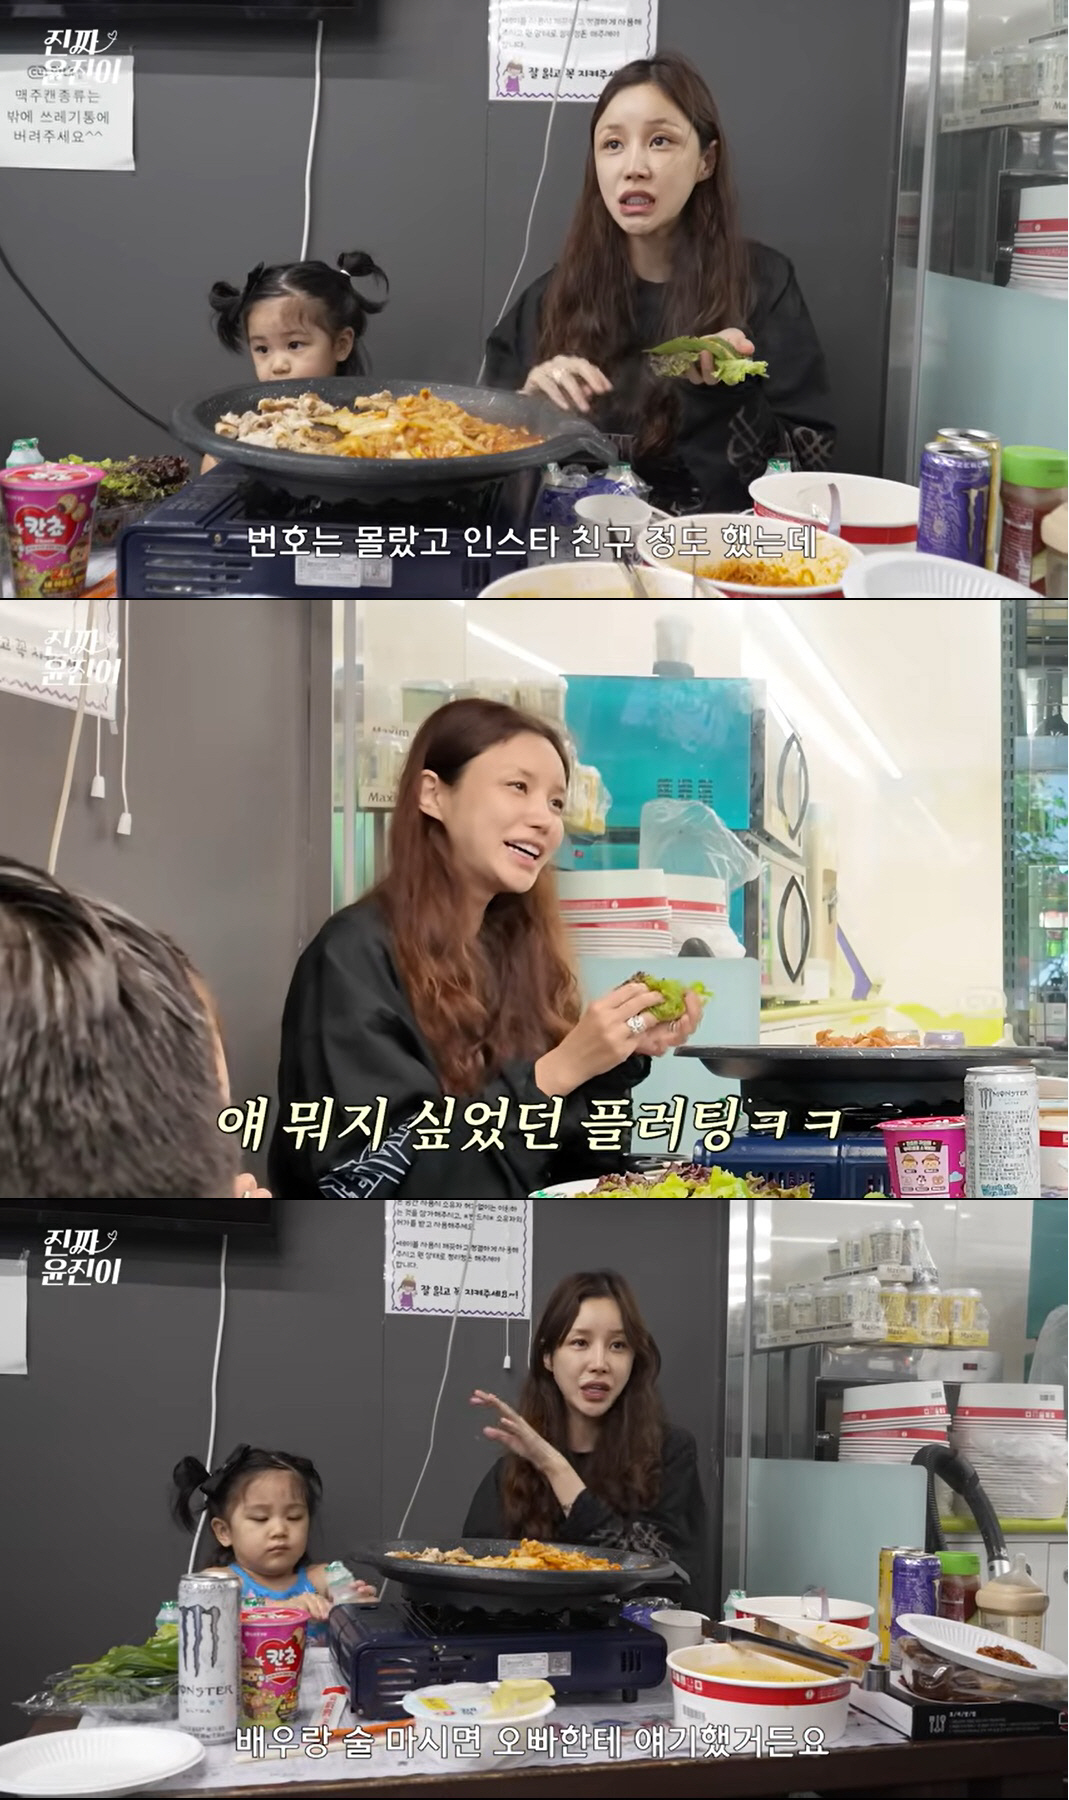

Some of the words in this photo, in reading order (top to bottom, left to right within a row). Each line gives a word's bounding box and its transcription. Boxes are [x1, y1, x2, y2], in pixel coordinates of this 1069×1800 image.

[15, 89, 100, 103] 맥주캔종류는
[7, 110, 33, 124] 밖에
[41, 111, 109, 124] 쓰레기통에
[368, 792, 395, 803] Max
[178, 1684, 234, 1696] ONSTER
